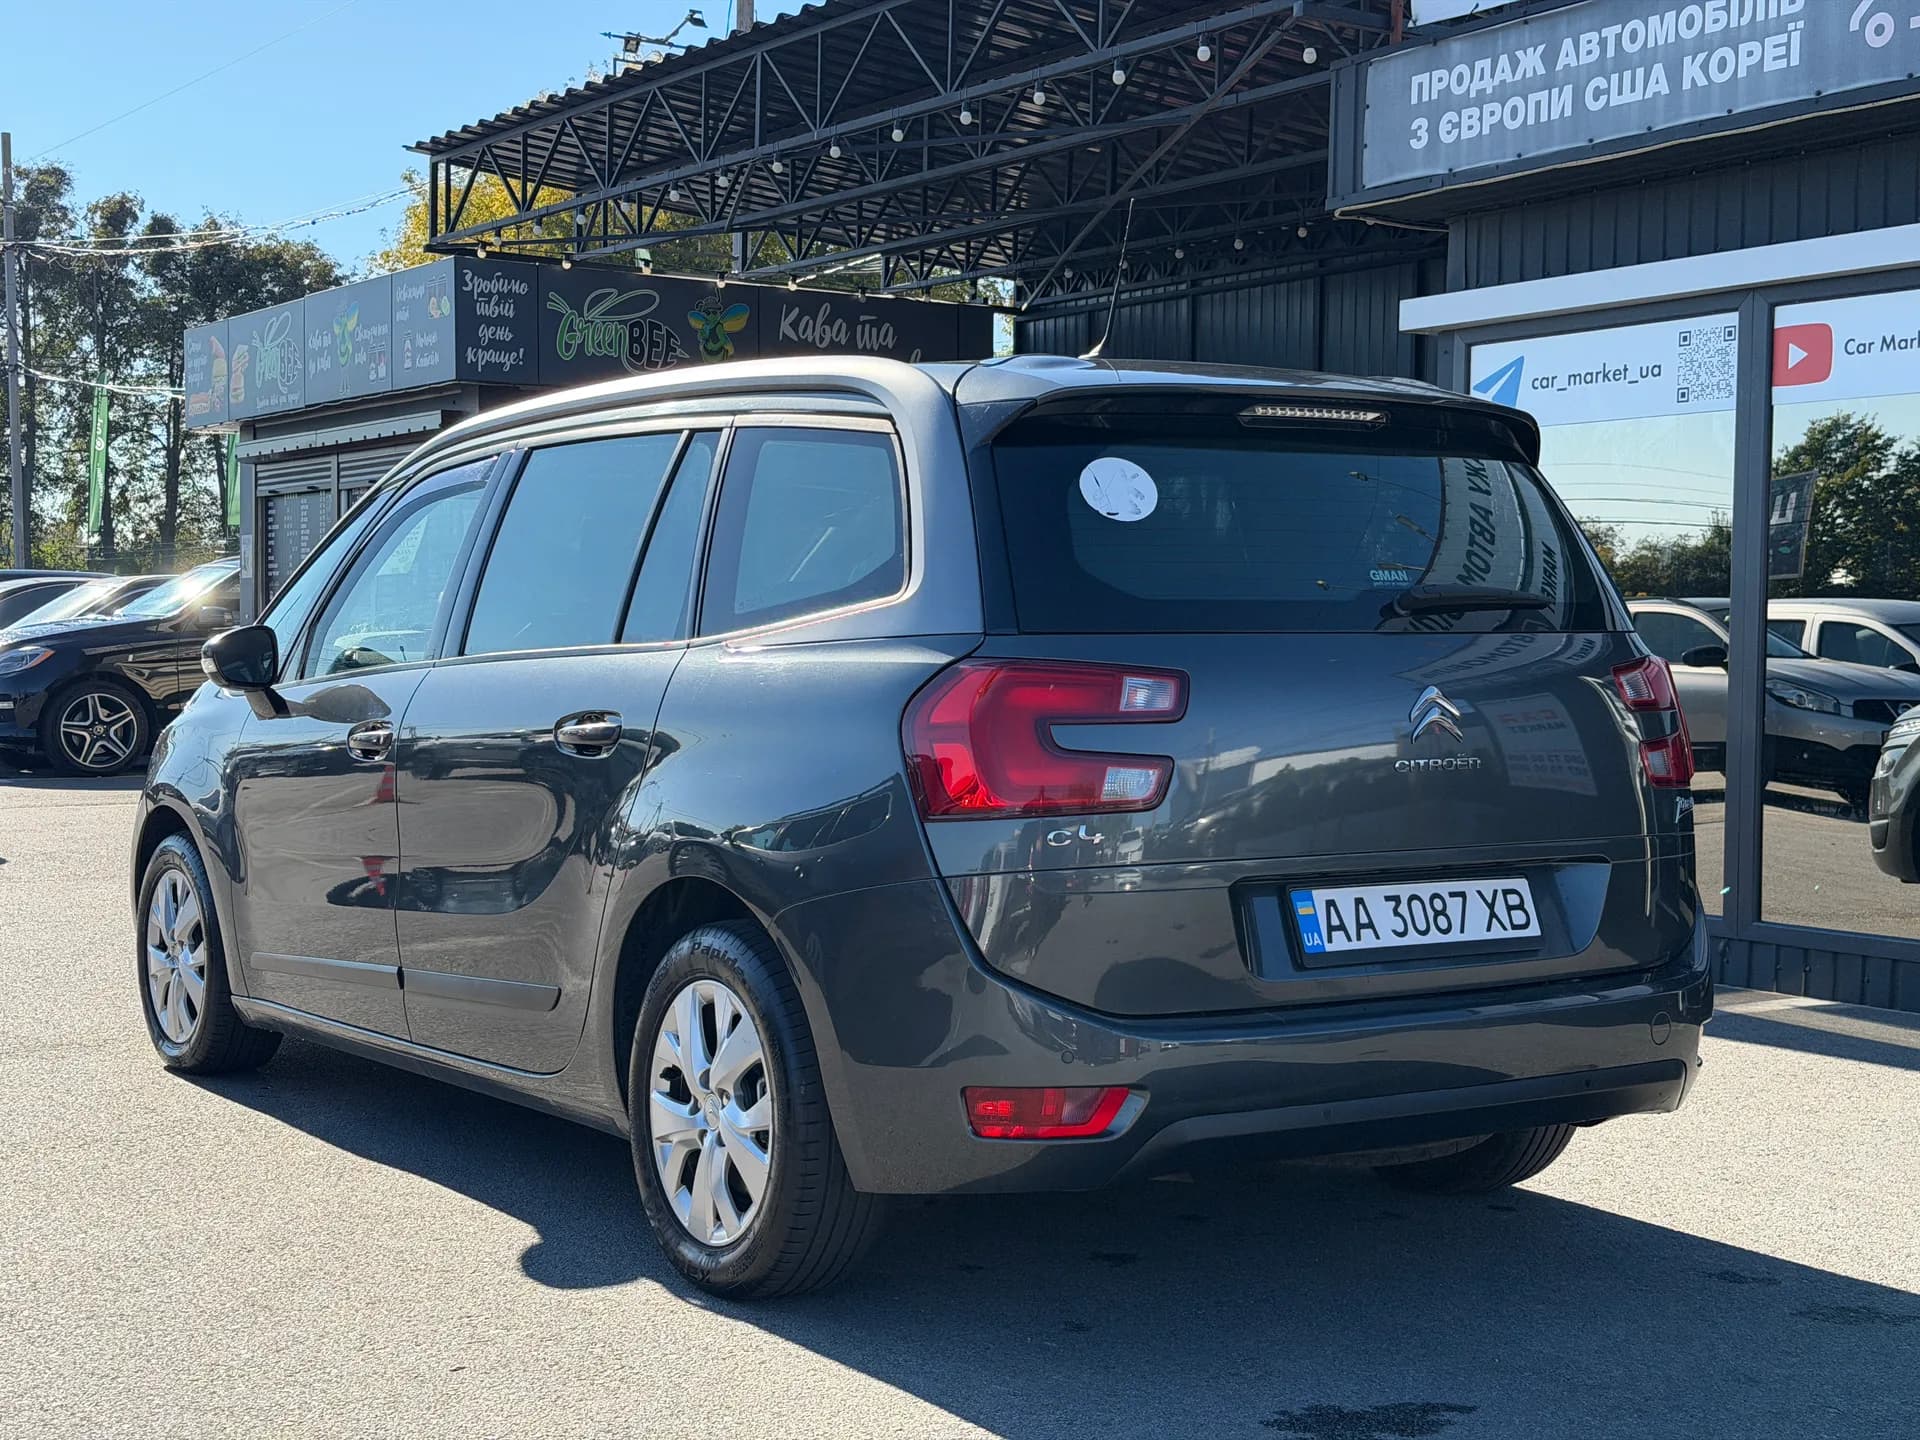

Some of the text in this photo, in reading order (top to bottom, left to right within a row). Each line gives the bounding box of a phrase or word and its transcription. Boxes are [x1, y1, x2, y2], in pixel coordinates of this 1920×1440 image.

[1409, 20, 1805, 150] З ЄВРОПИ США КОРЕЇ
[1410, 43, 1547, 105] ПРОДАЖ
[462, 269, 529, 300] Зробимо
[476, 298, 515, 319] твій
[478, 323, 515, 346] день
[779, 302, 898, 351] Кава та
[1844, 338, 1875, 356] Car
[1531, 362, 1662, 392] car_market_ua
[1369, 569, 1409, 581] GMAN
[1394, 752, 1481, 773] CITROËN
[1046, 824, 1105, 847] C4
[1325, 888, 1532, 944] AA 3087 XB
[1303, 931, 1323, 947] UA
